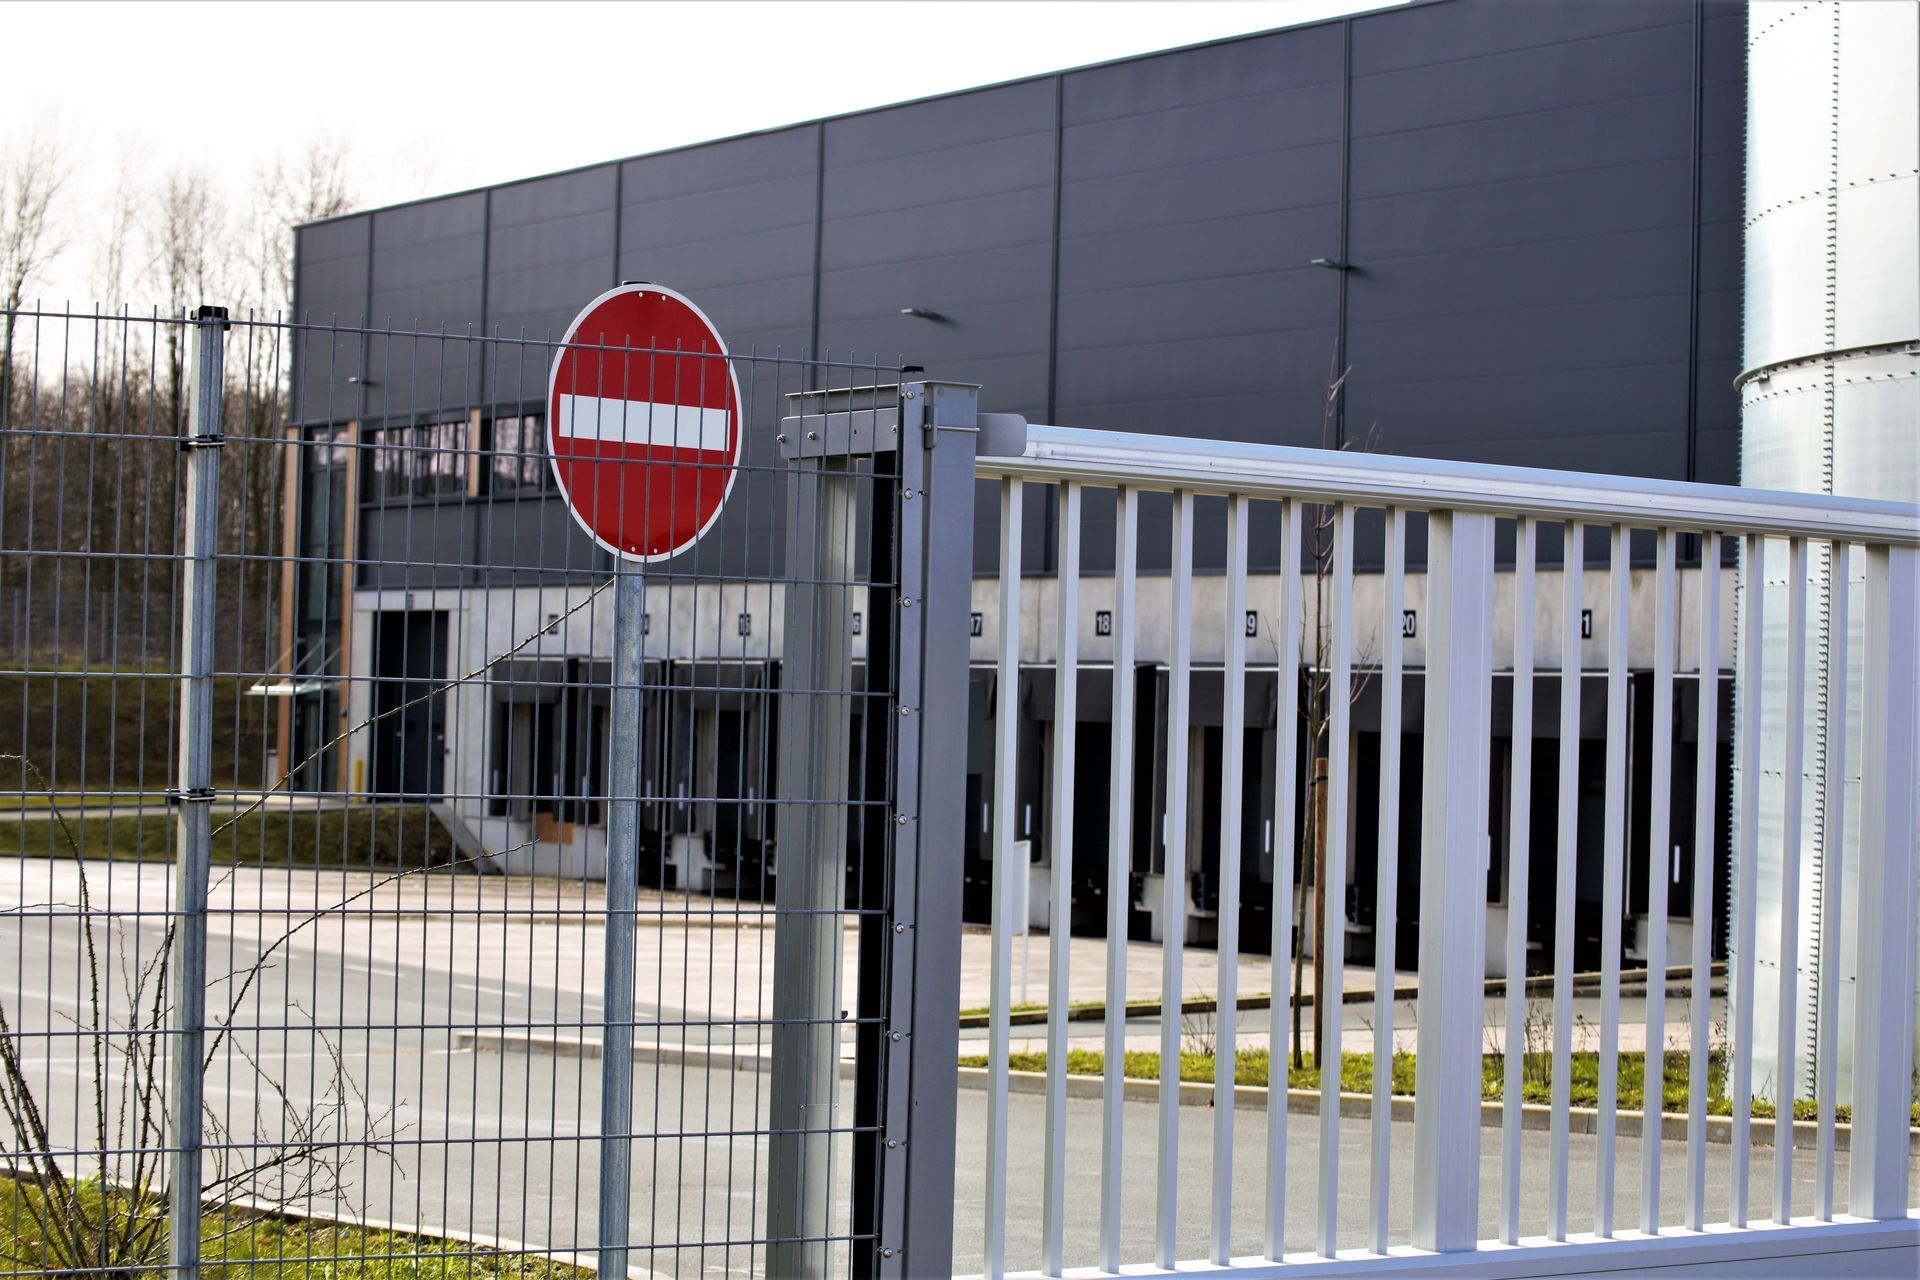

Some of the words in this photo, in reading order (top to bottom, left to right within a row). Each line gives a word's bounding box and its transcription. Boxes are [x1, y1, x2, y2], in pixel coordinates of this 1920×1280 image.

[853, 614, 860, 632] 6
[1097, 614, 1109, 633] 18
[1247, 614, 1256, 634] 9
[1583, 613, 1590, 635] 1
